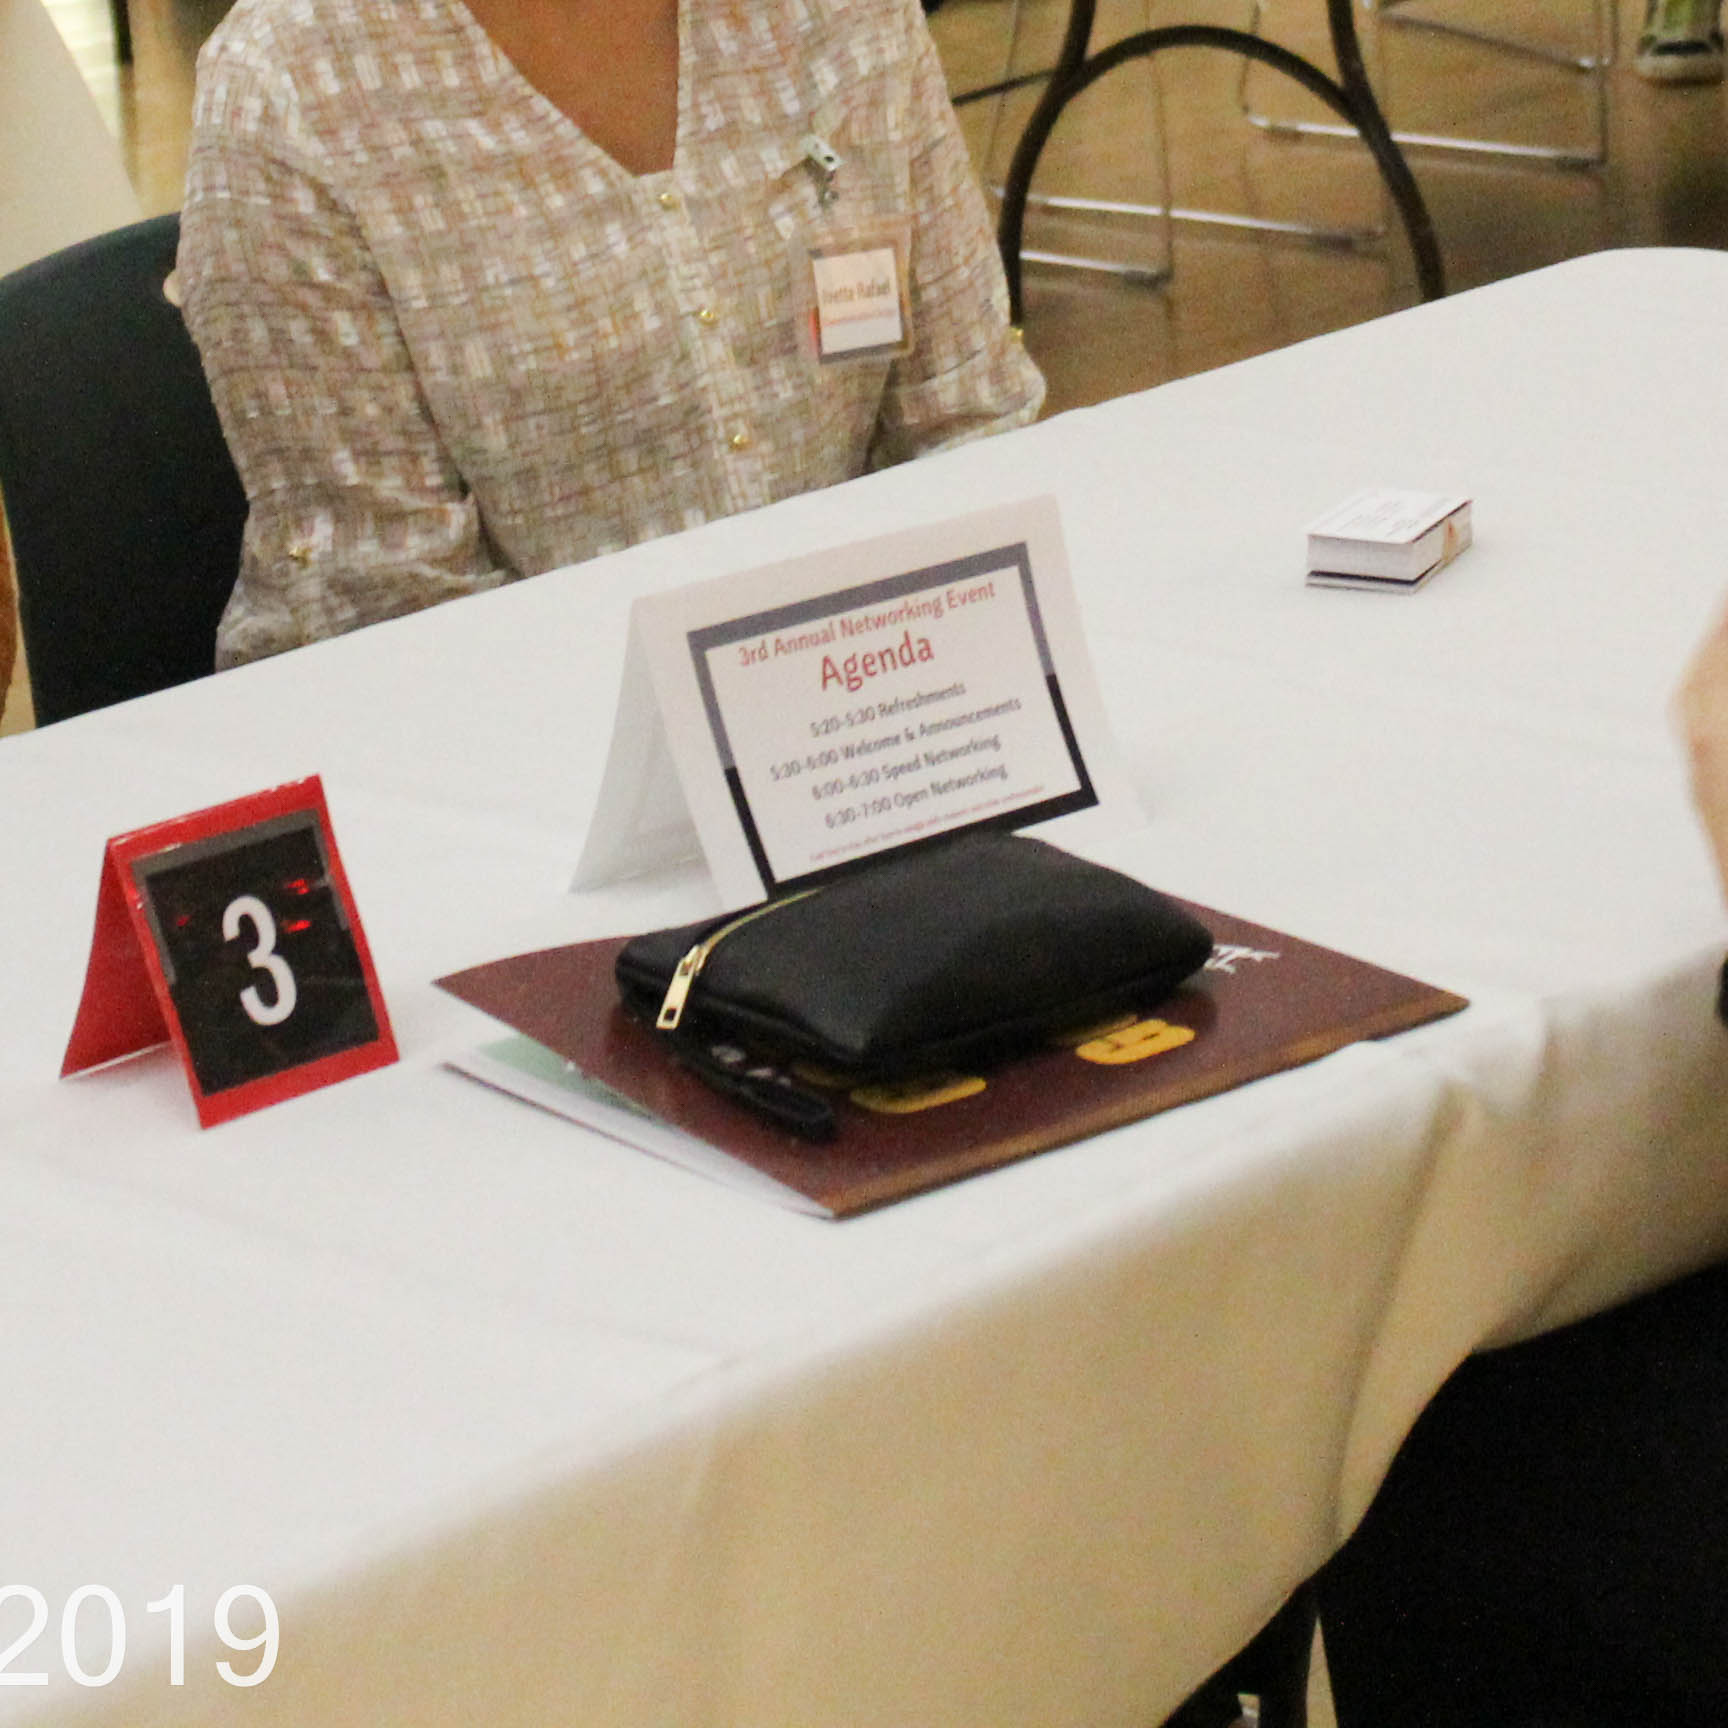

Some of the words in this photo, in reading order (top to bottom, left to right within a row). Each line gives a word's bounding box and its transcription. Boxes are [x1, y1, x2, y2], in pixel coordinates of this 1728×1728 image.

[737, 638, 768, 667] 3rd
[774, 624, 837, 658] Annual
[839, 594, 944, 640] Networking
[946, 580, 996, 610] Event
[820, 629, 935, 693] Agenda
[841, 732, 903, 761] Welcome
[903, 726, 916, 743] &
[919, 696, 1023, 739] Announcements
[877, 682, 967, 719] Refreshments
[880, 757, 923, 782] Speed
[923, 733, 1003, 768] Networking
[893, 786, 930, 812] Open
[930, 762, 1010, 796] Networking
[221, 893, 298, 1028] 3
